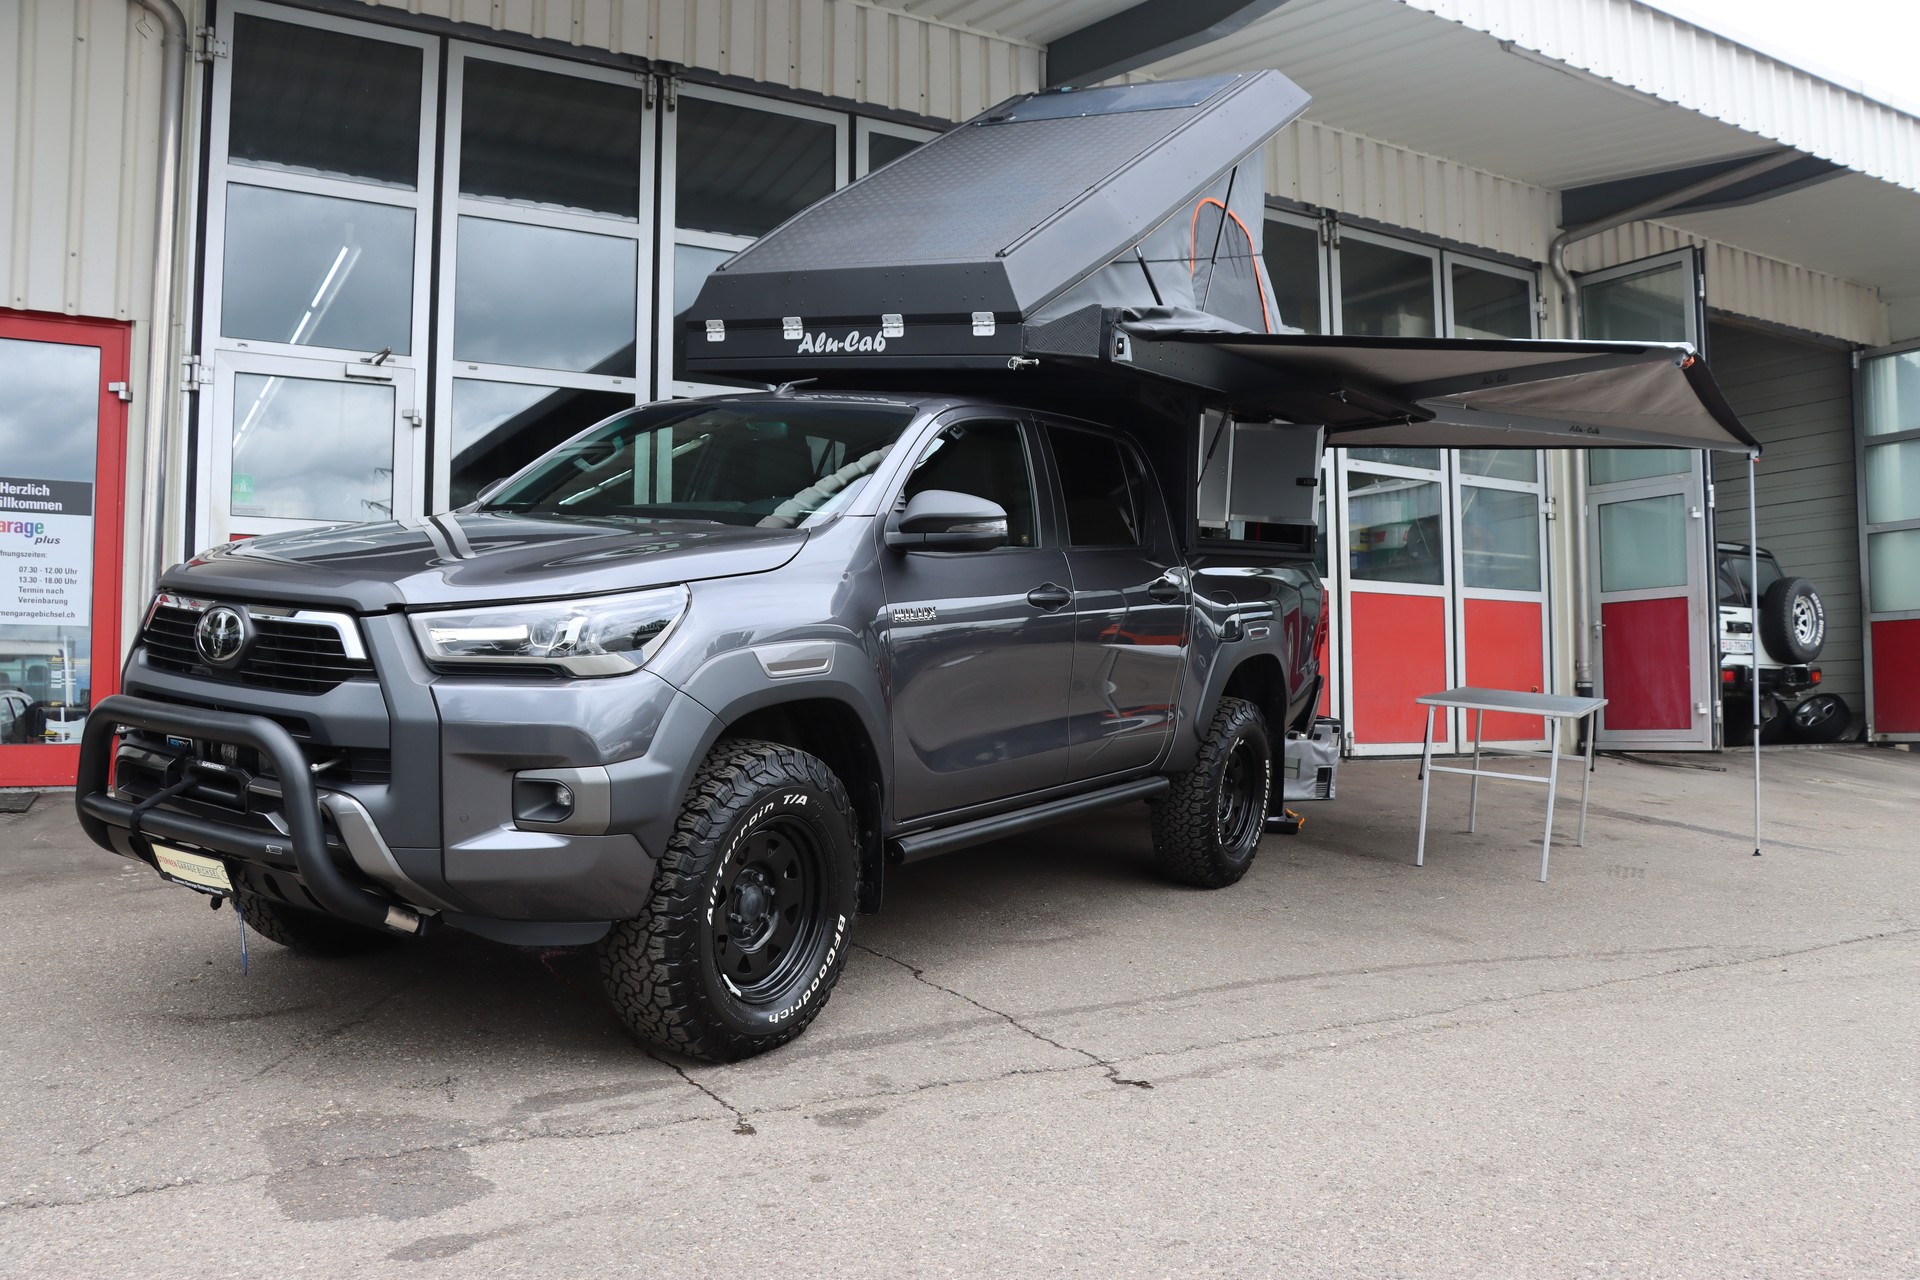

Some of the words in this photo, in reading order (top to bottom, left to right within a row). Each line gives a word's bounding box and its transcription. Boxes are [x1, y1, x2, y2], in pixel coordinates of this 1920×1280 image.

[797, 330, 886, 354] Alu-Cab
[0, 482, 50, 496] Herzlich
[34, 536, 61, 545] plus
[44, 567, 63, 575] 12.00
[64, 567, 78, 575] Uhr
[18, 576, 38, 584] 13.30
[44, 577, 63, 585] 18.00
[18, 586, 44, 594] Termin
[18, 596, 69, 606] Vereinbarung
[893, 606, 938, 623] HILUX
[782, 793, 809, 806] T/A
[768, 913, 847, 1025] BFGoodrich
